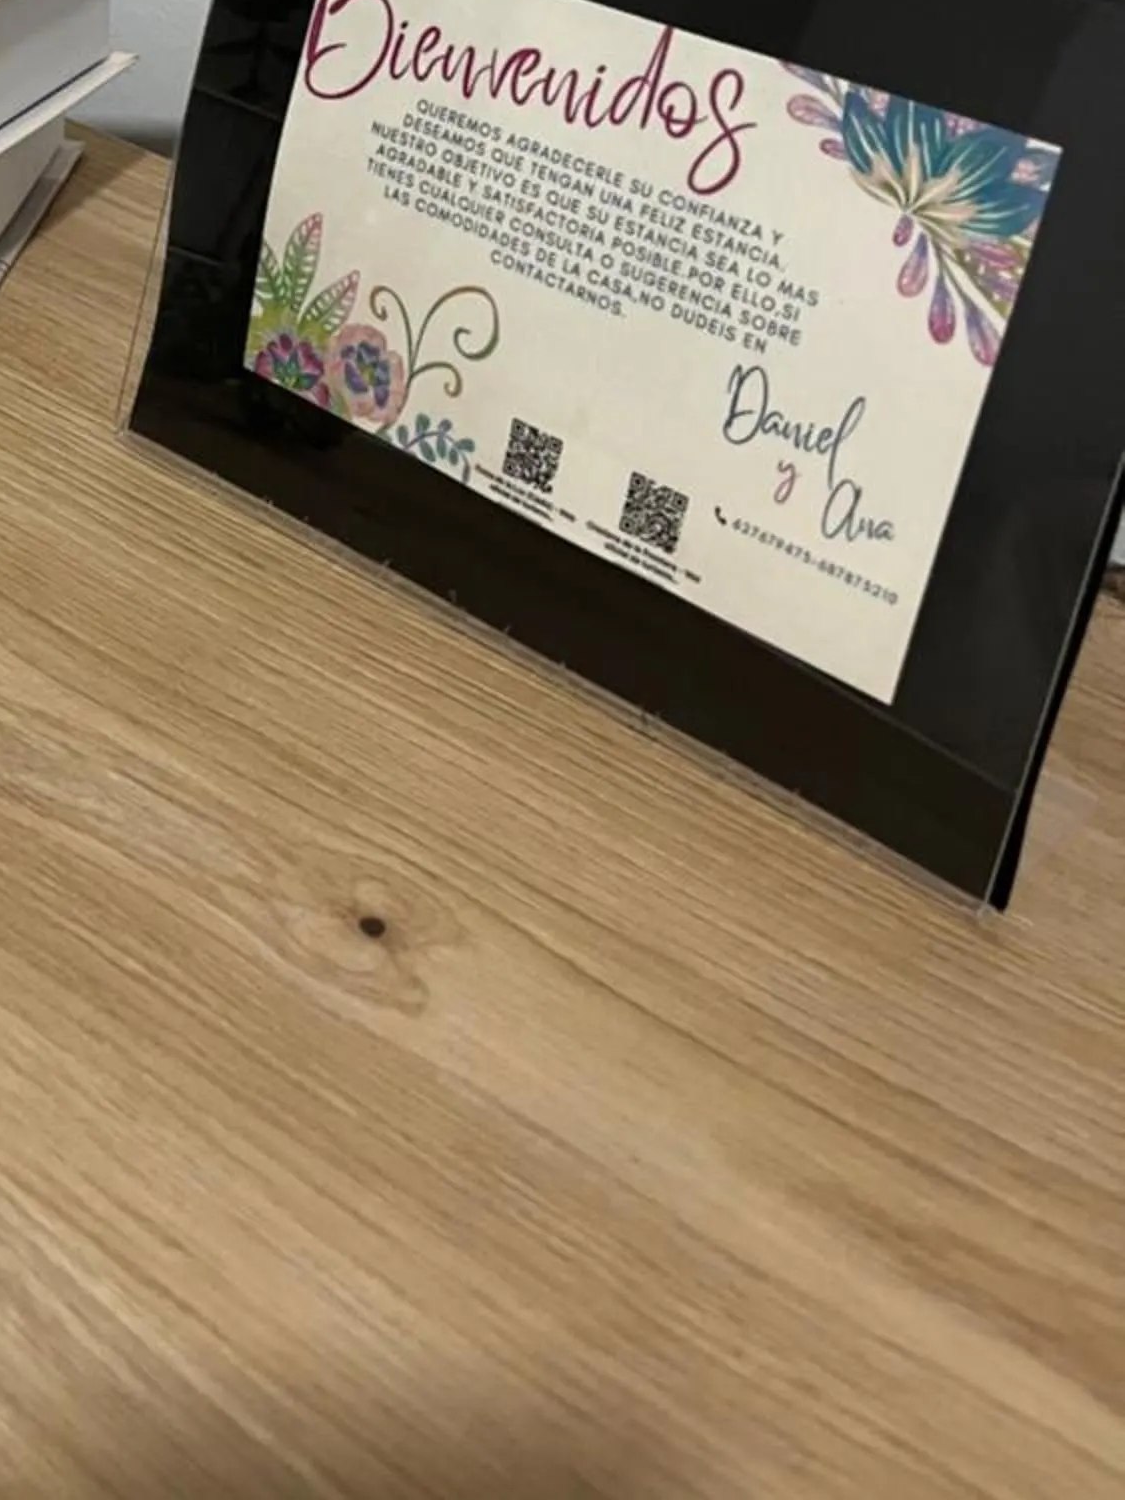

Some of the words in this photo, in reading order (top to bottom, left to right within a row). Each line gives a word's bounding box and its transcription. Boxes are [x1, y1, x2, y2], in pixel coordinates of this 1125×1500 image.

[370, 120, 438, 159] NUESTRO
[440, 148, 517, 189] OBJETIVO
[519, 178, 542, 200] ES
[545, 189, 582, 215] QUE
[585, 204, 610, 226] SU
[613, 214, 699, 262] ESTANCIA
[704, 249, 740, 278] SEA
[746, 266, 772, 289] LO
[776, 279, 819, 307] MAS
[375, 142, 464, 189] AGRADABLE
[467, 177, 479, 194] Y
[402, 112, 487, 157] DESEAMOS
[490, 147, 525, 173] QUE
[530, 160, 596, 199] TENGAN
[598, 187, 634, 215] UNA
[638, 203, 687, 234] FELIZ
[415, 98, 502, 143] QUEREMOS
[505, 133, 625, 189] AGRADECERLE
[628, 178, 654, 199] SU
[657, 189, 763, 241] CONFIANZA
[772, 229, 784, 246] Y
[367, 156, 415, 189] TIENES
[418, 179, 506, 226] CUALQUIER
[508, 216, 594, 264] CONSULTA
[599, 253, 616, 270] O
[618, 260, 732, 319] SUGERENCIA
[737, 309, 802, 347] SOBRE
[383, 184, 411, 207] LAS
[413, 196, 531, 257] COMODIDADES
[534, 247, 557, 269] DE
[561, 258, 581, 278] LA
[669, 302, 738, 342] DUDEIS
[741, 331, 768, 355] EN
[722, 363, 866, 490] Daniel
[775, 460, 801, 503] y
[820, 479, 896, 544] Ana
